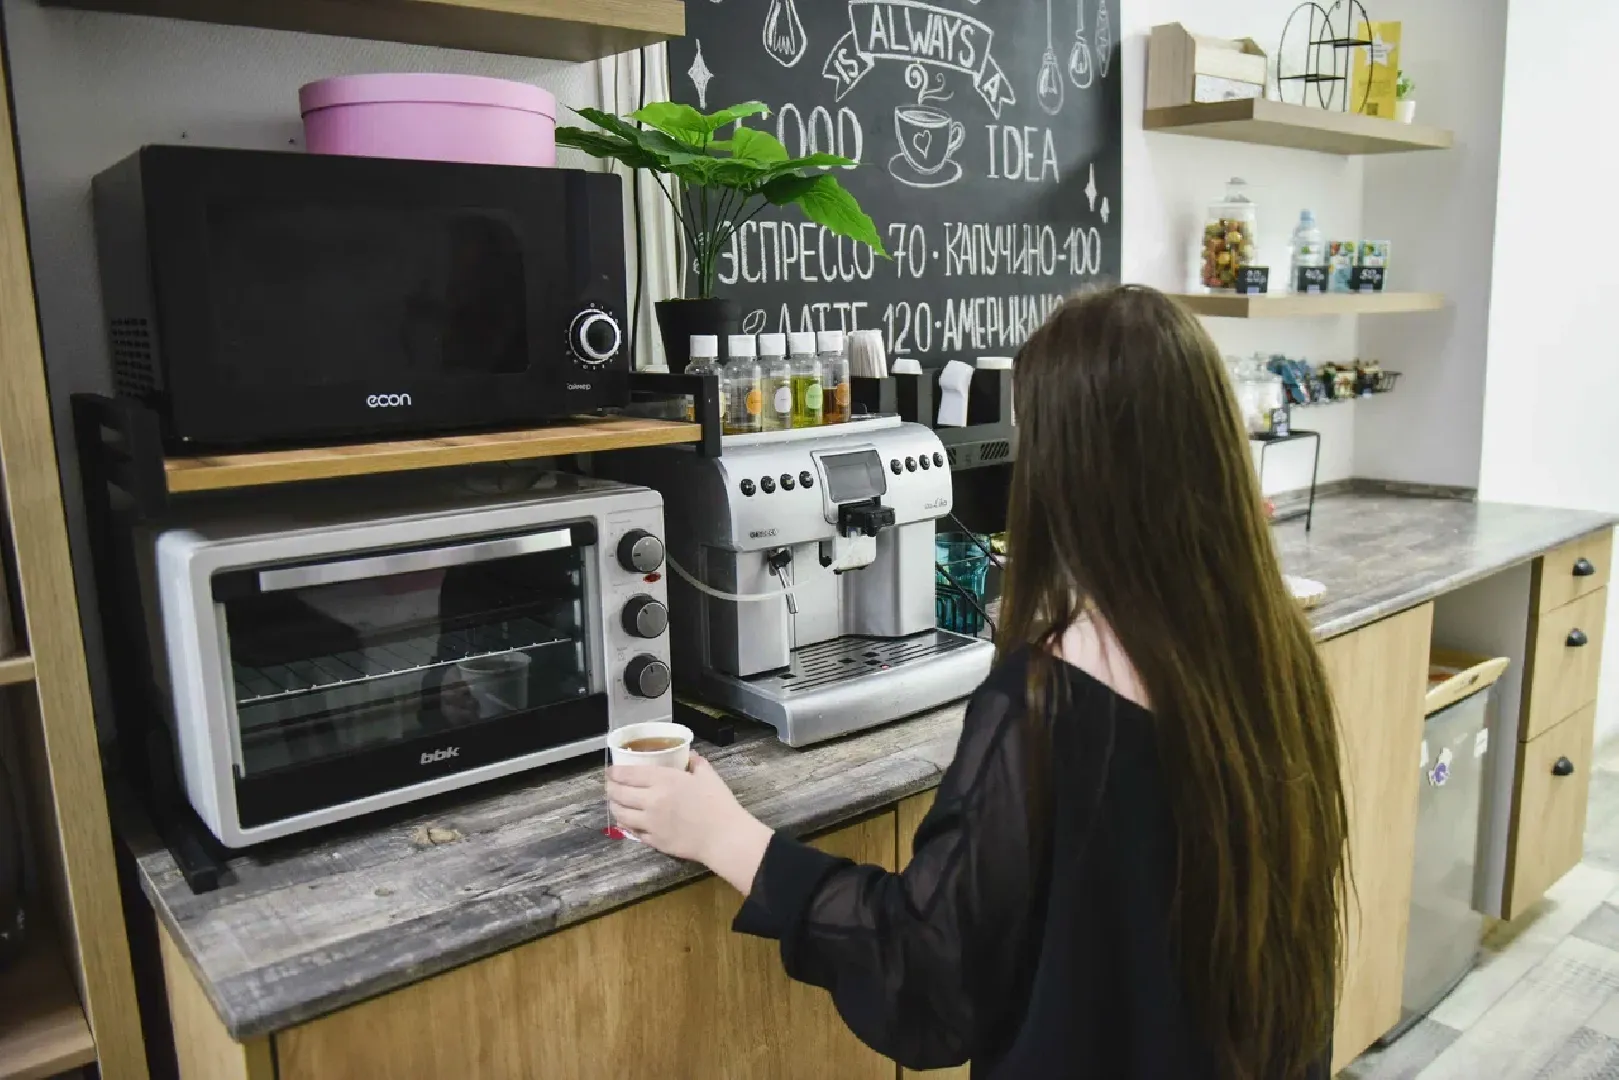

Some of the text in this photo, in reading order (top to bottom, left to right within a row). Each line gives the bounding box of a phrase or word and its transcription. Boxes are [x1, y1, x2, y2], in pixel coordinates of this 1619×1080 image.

[833, 4, 1001, 102] IS ALWAYS A
[735, 101, 1060, 183] OOD IDEA
[717, 220, 875, 284] ЭСПРЕССО
[366, 393, 412, 408] econ
[420, 746, 460, 765] bbk
